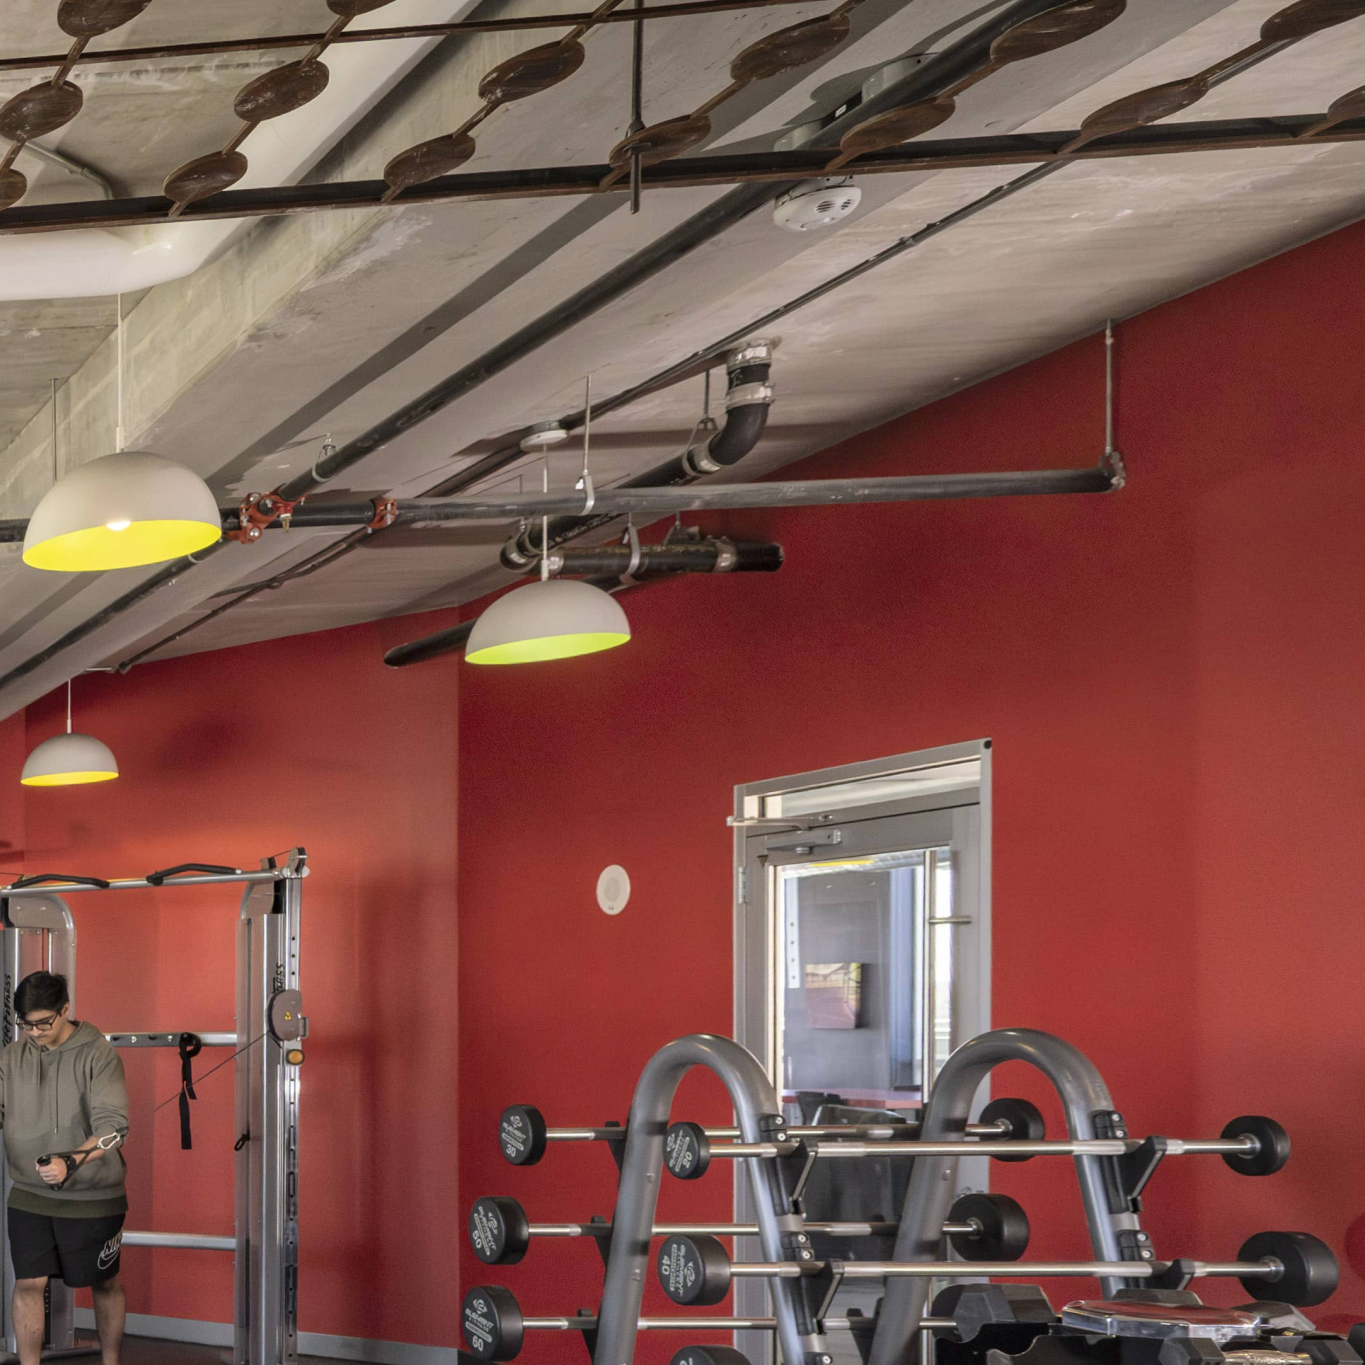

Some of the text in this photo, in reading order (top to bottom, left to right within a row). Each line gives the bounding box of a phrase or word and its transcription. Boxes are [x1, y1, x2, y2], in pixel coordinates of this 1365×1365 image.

[506, 1144, 517, 1158] 30
[682, 1151, 693, 1169] 20
[472, 1230, 482, 1249] 50
[662, 1255, 671, 1275] 40
[465, 1308, 494, 1329] ELEMENT
[472, 1335, 484, 1352] 60
